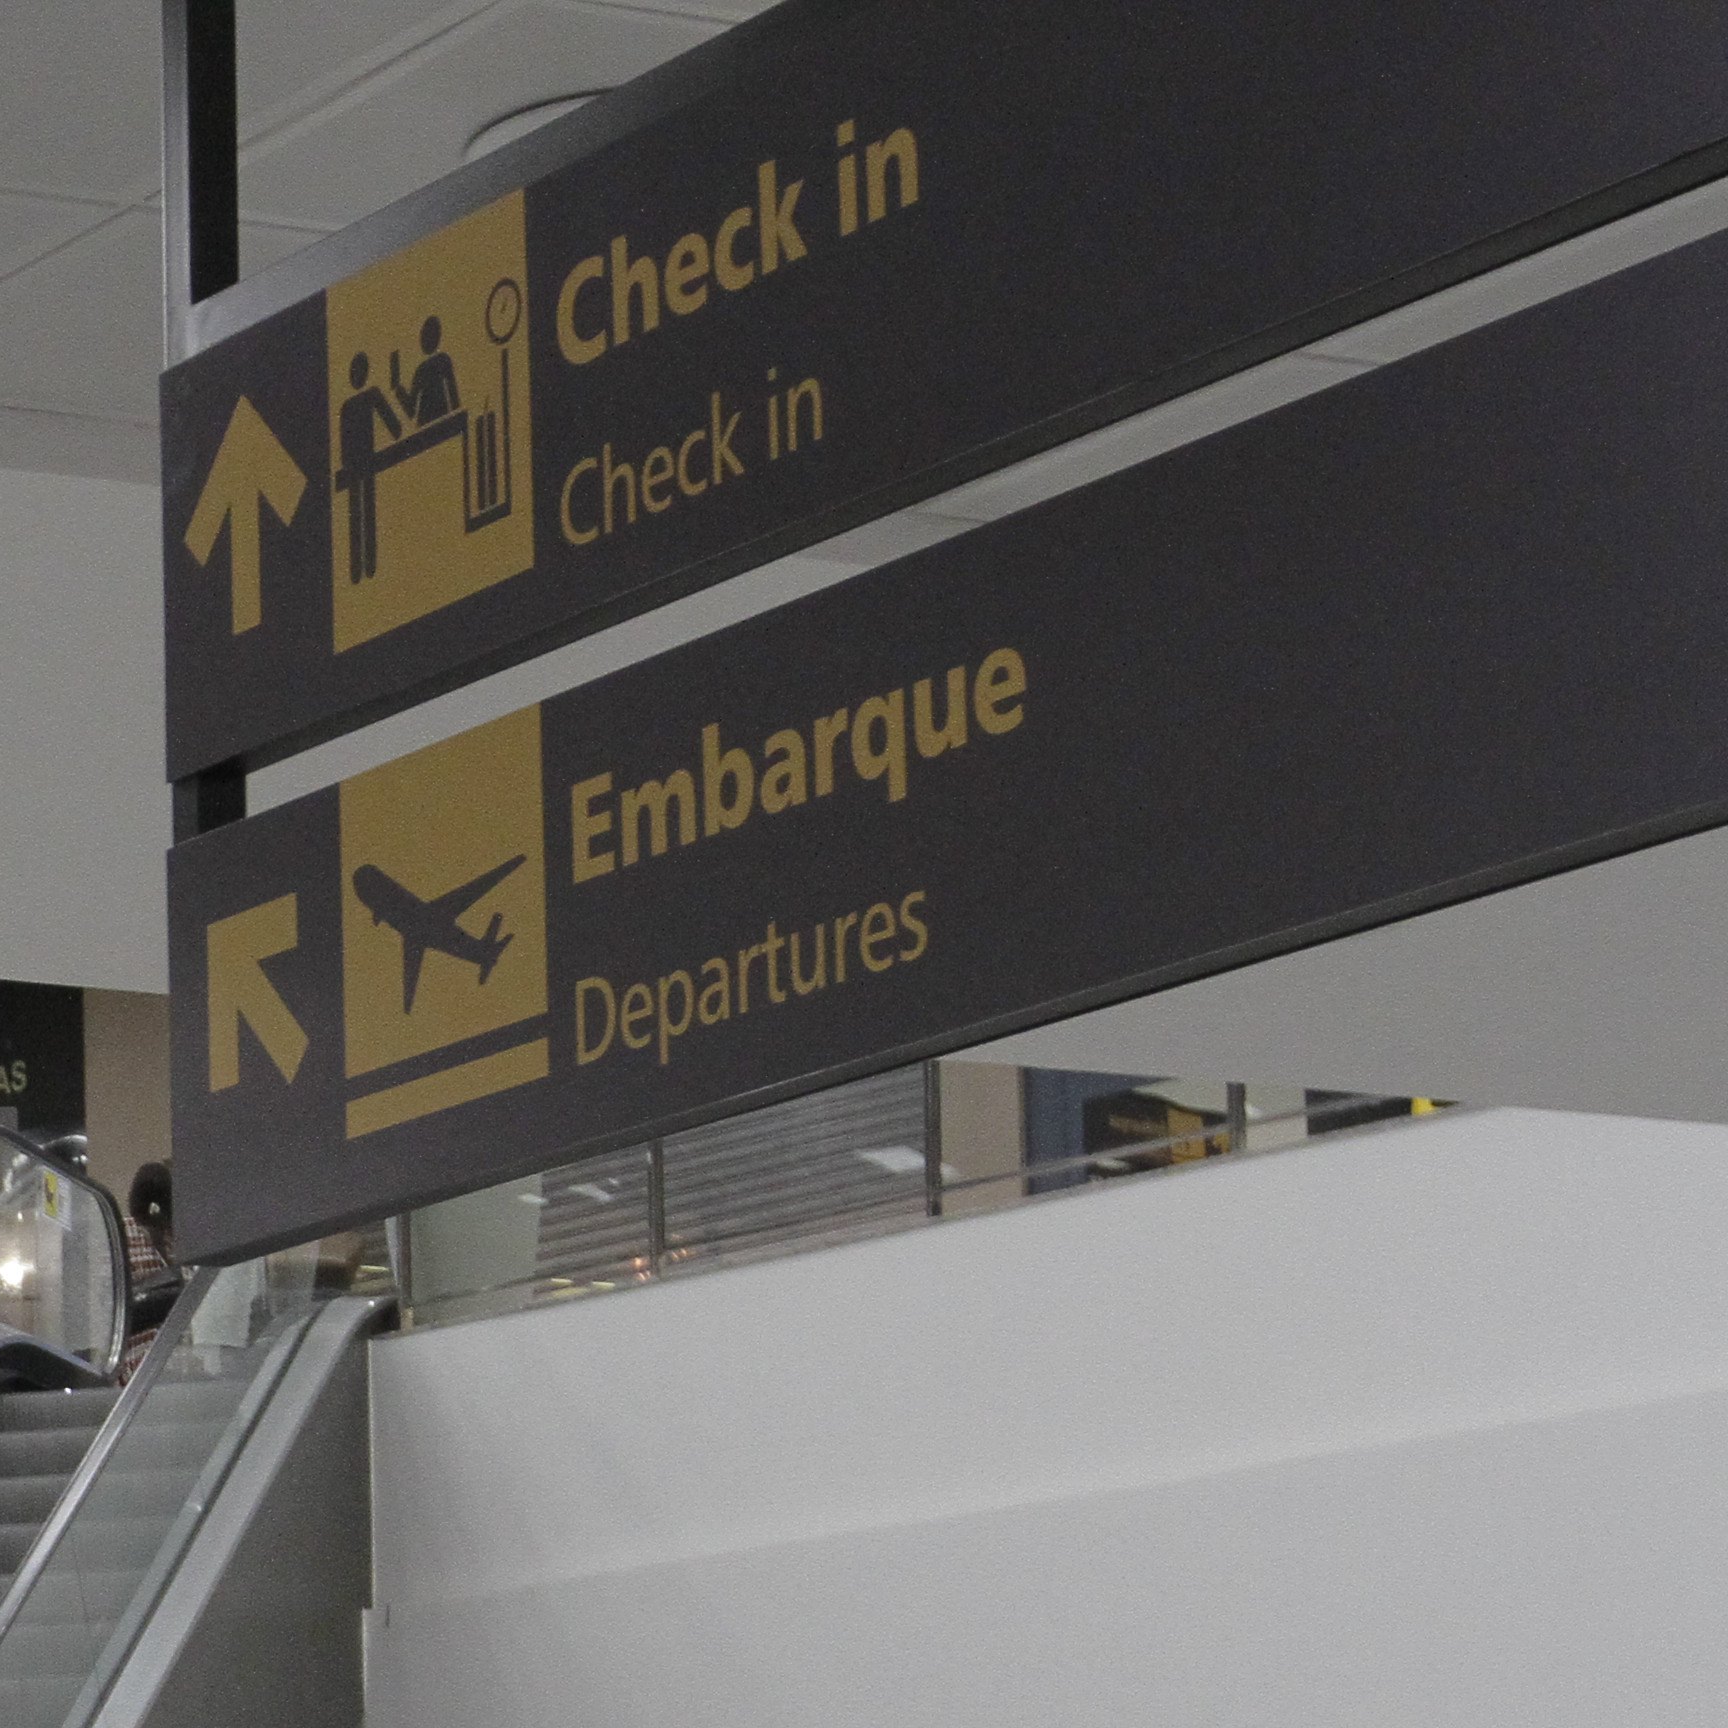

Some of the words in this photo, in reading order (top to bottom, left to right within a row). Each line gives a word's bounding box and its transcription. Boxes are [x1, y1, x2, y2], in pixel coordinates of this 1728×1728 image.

[555, 160, 808, 364] Check
[836, 118, 920, 237] in
[559, 392, 745, 546] Check
[766, 368, 825, 460] in
[571, 645, 1027, 884] Embarque
[575, 891, 929, 1066] Departures
